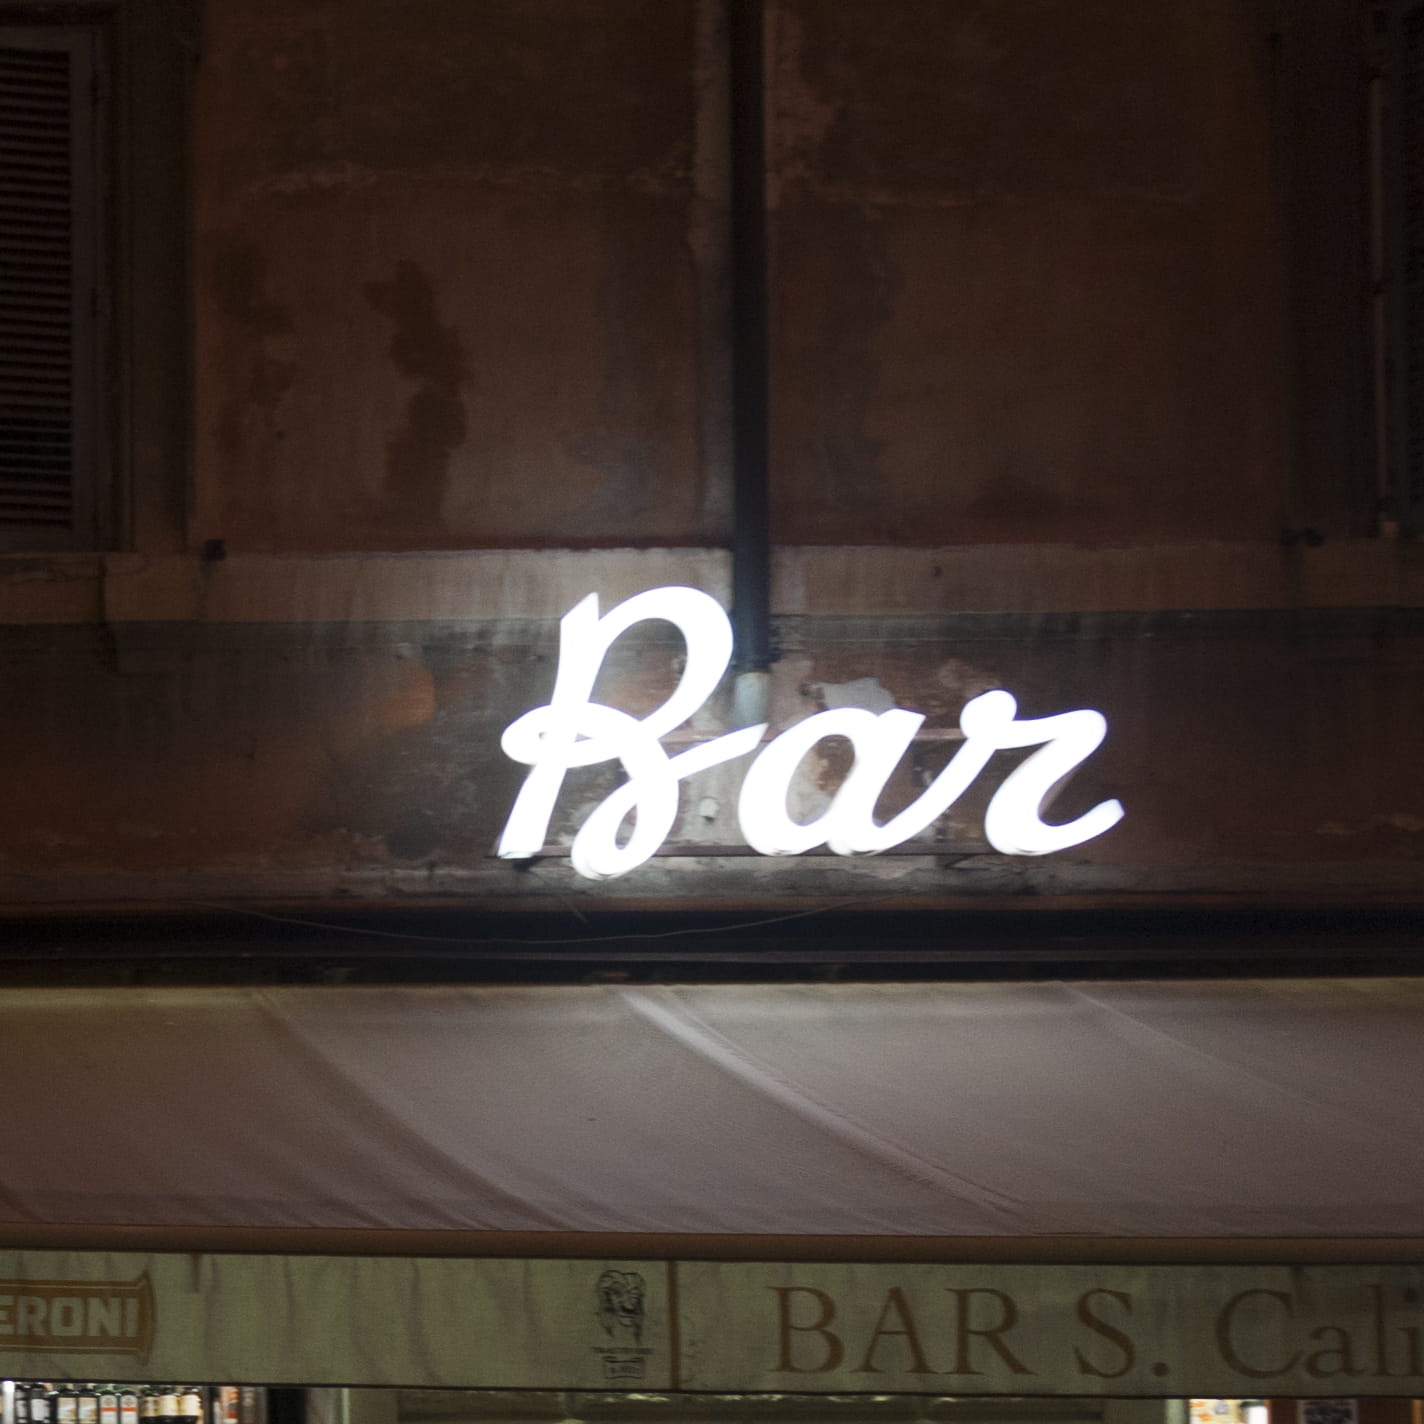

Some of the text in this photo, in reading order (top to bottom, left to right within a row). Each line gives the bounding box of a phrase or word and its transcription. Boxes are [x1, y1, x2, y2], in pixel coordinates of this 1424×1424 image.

[496, 586, 1126, 880] Bar
[767, 1285, 1038, 1376] BAR
[1073, 1287, 1170, 1379] S.
